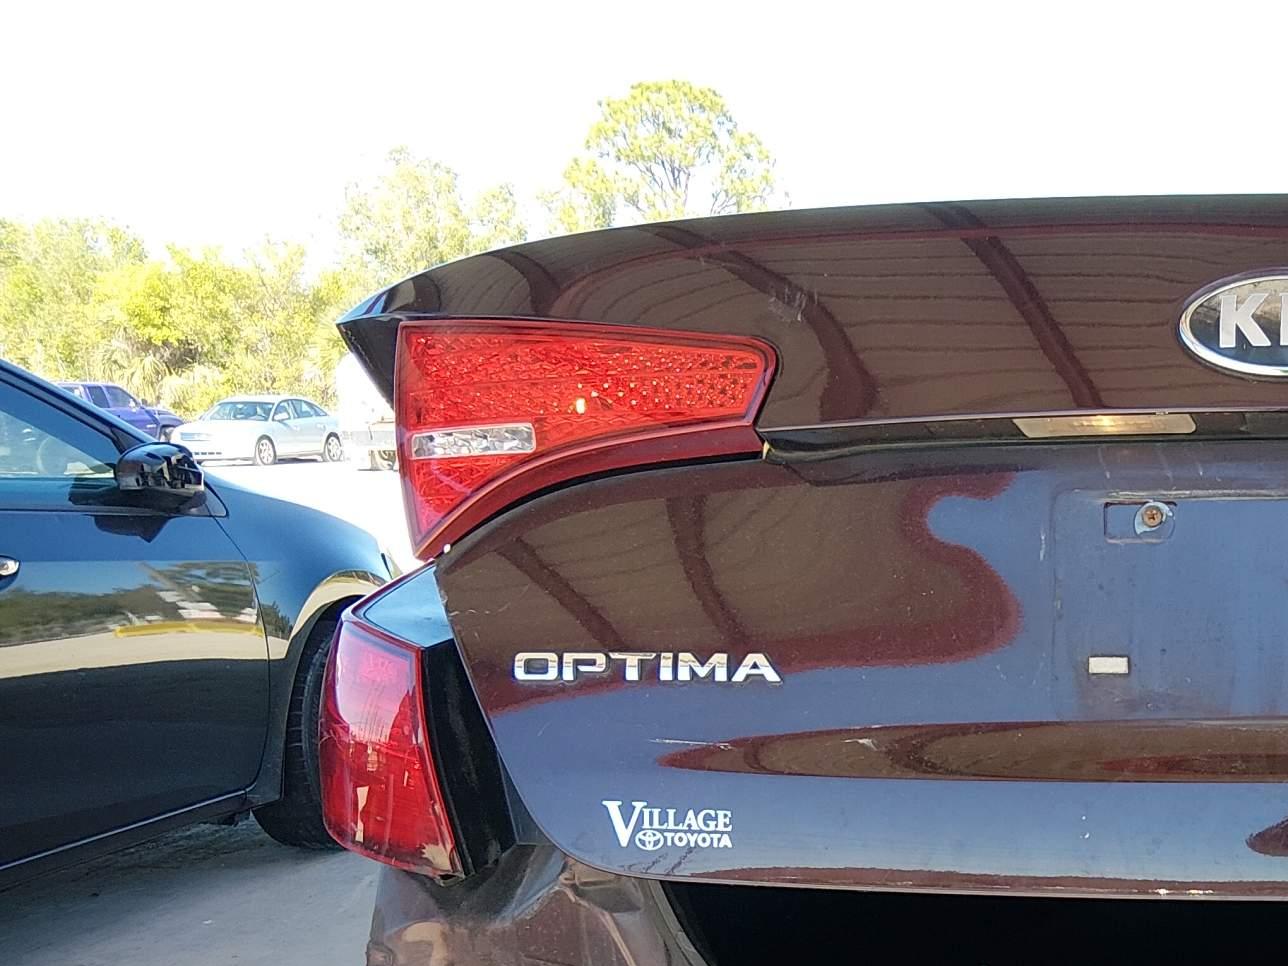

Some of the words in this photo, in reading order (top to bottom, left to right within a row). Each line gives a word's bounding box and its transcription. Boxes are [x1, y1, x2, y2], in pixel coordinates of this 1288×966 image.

[513, 651, 782, 683] OPTIMA
[602, 800, 733, 848] VILLAGE
[664, 833, 733, 849] TOYOTA
